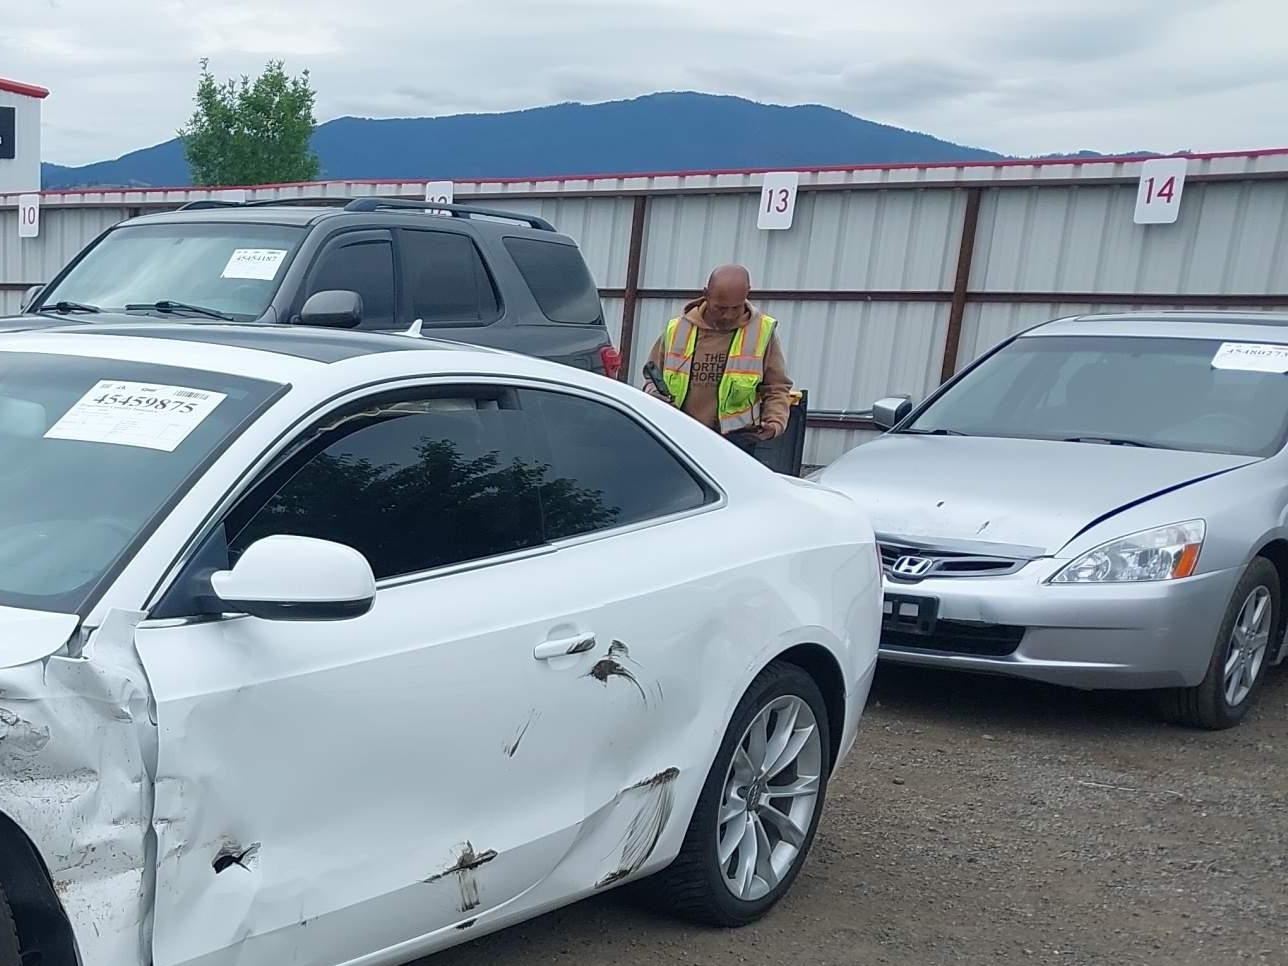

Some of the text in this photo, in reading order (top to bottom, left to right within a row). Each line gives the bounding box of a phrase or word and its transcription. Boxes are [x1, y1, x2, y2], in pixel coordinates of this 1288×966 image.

[1145, 176, 1176, 204] 14
[766, 188, 789, 213] 13
[22, 206, 36, 225] 10
[692, 362, 726, 371] ORTH
[704, 353, 726, 362] THE
[691, 372, 722, 381] HORE
[93, 393, 200, 413] 45459875
